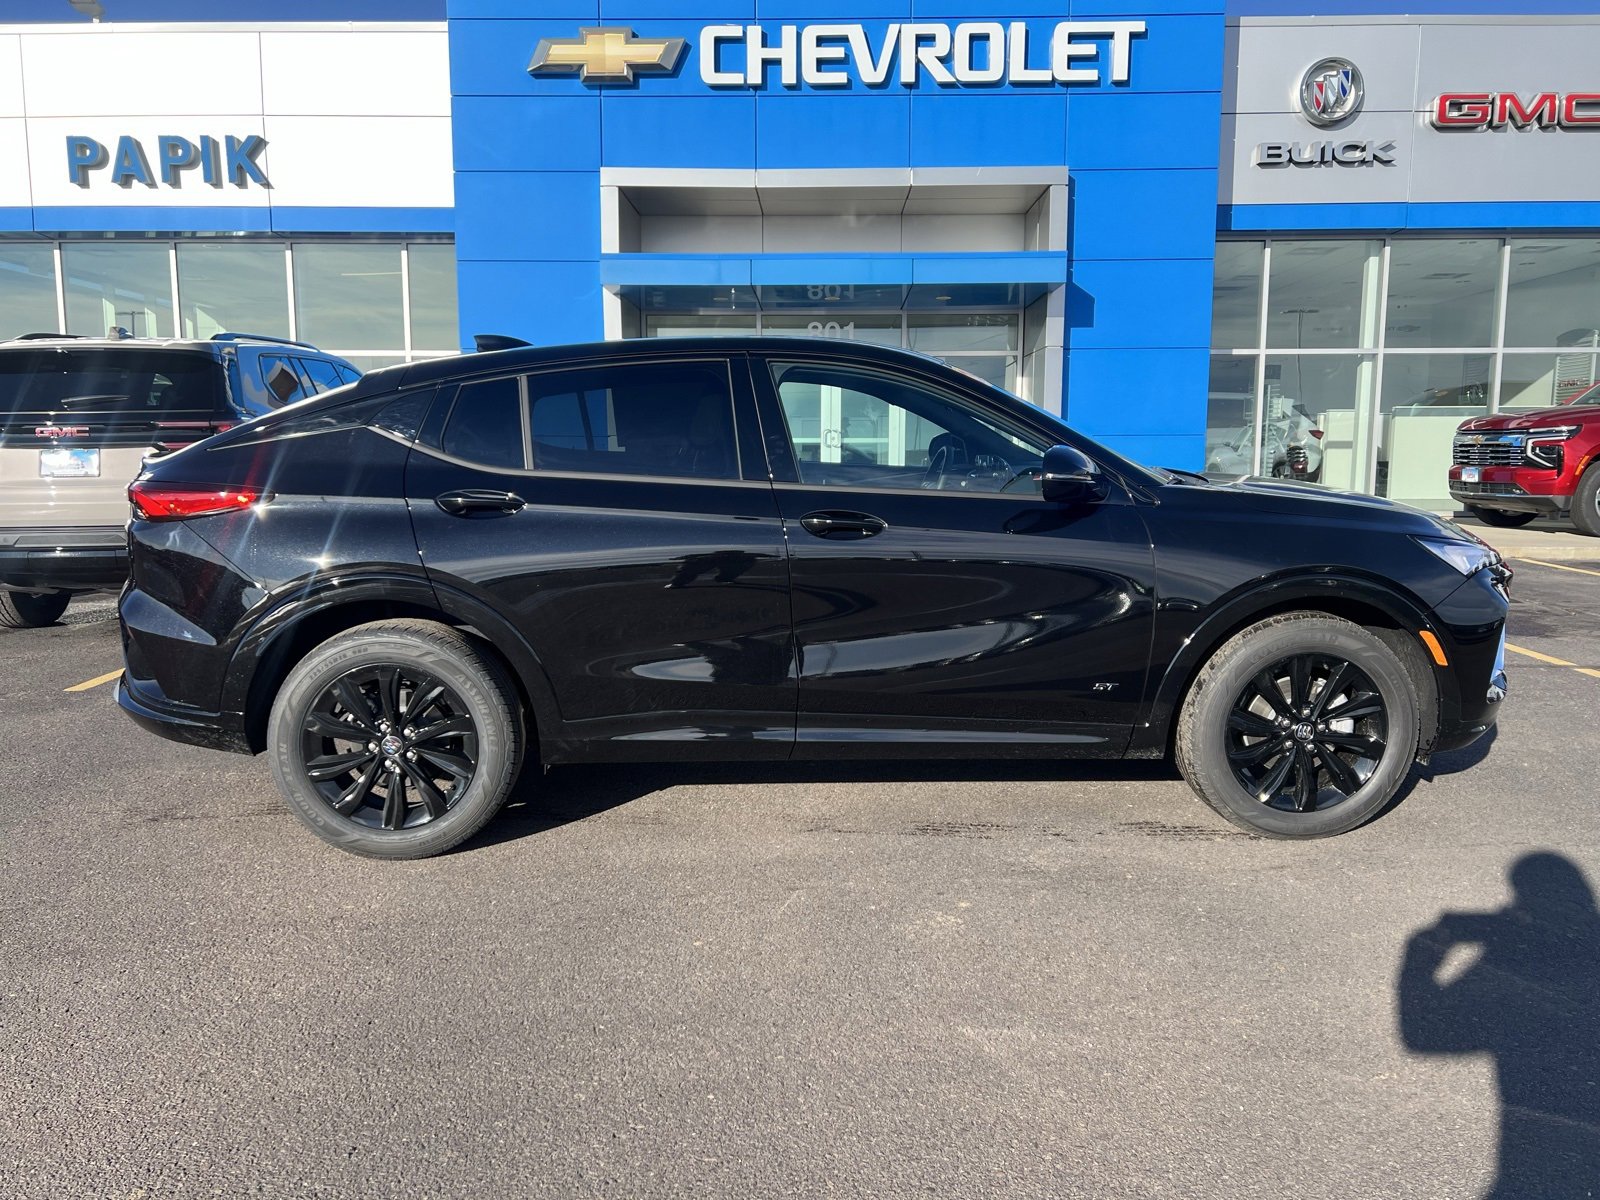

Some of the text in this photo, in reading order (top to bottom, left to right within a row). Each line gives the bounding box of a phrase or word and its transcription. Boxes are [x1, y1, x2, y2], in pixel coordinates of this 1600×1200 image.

[699, 21, 1146, 86] CHEVROLET
[1434, 92, 1600, 127] GMC
[66, 135, 271, 187] PAPIK
[1256, 140, 1397, 165] BUICK
[807, 321, 855, 340] 801
[35, 427, 90, 438] GMC
[455, 674, 499, 753] ASSURANCE
